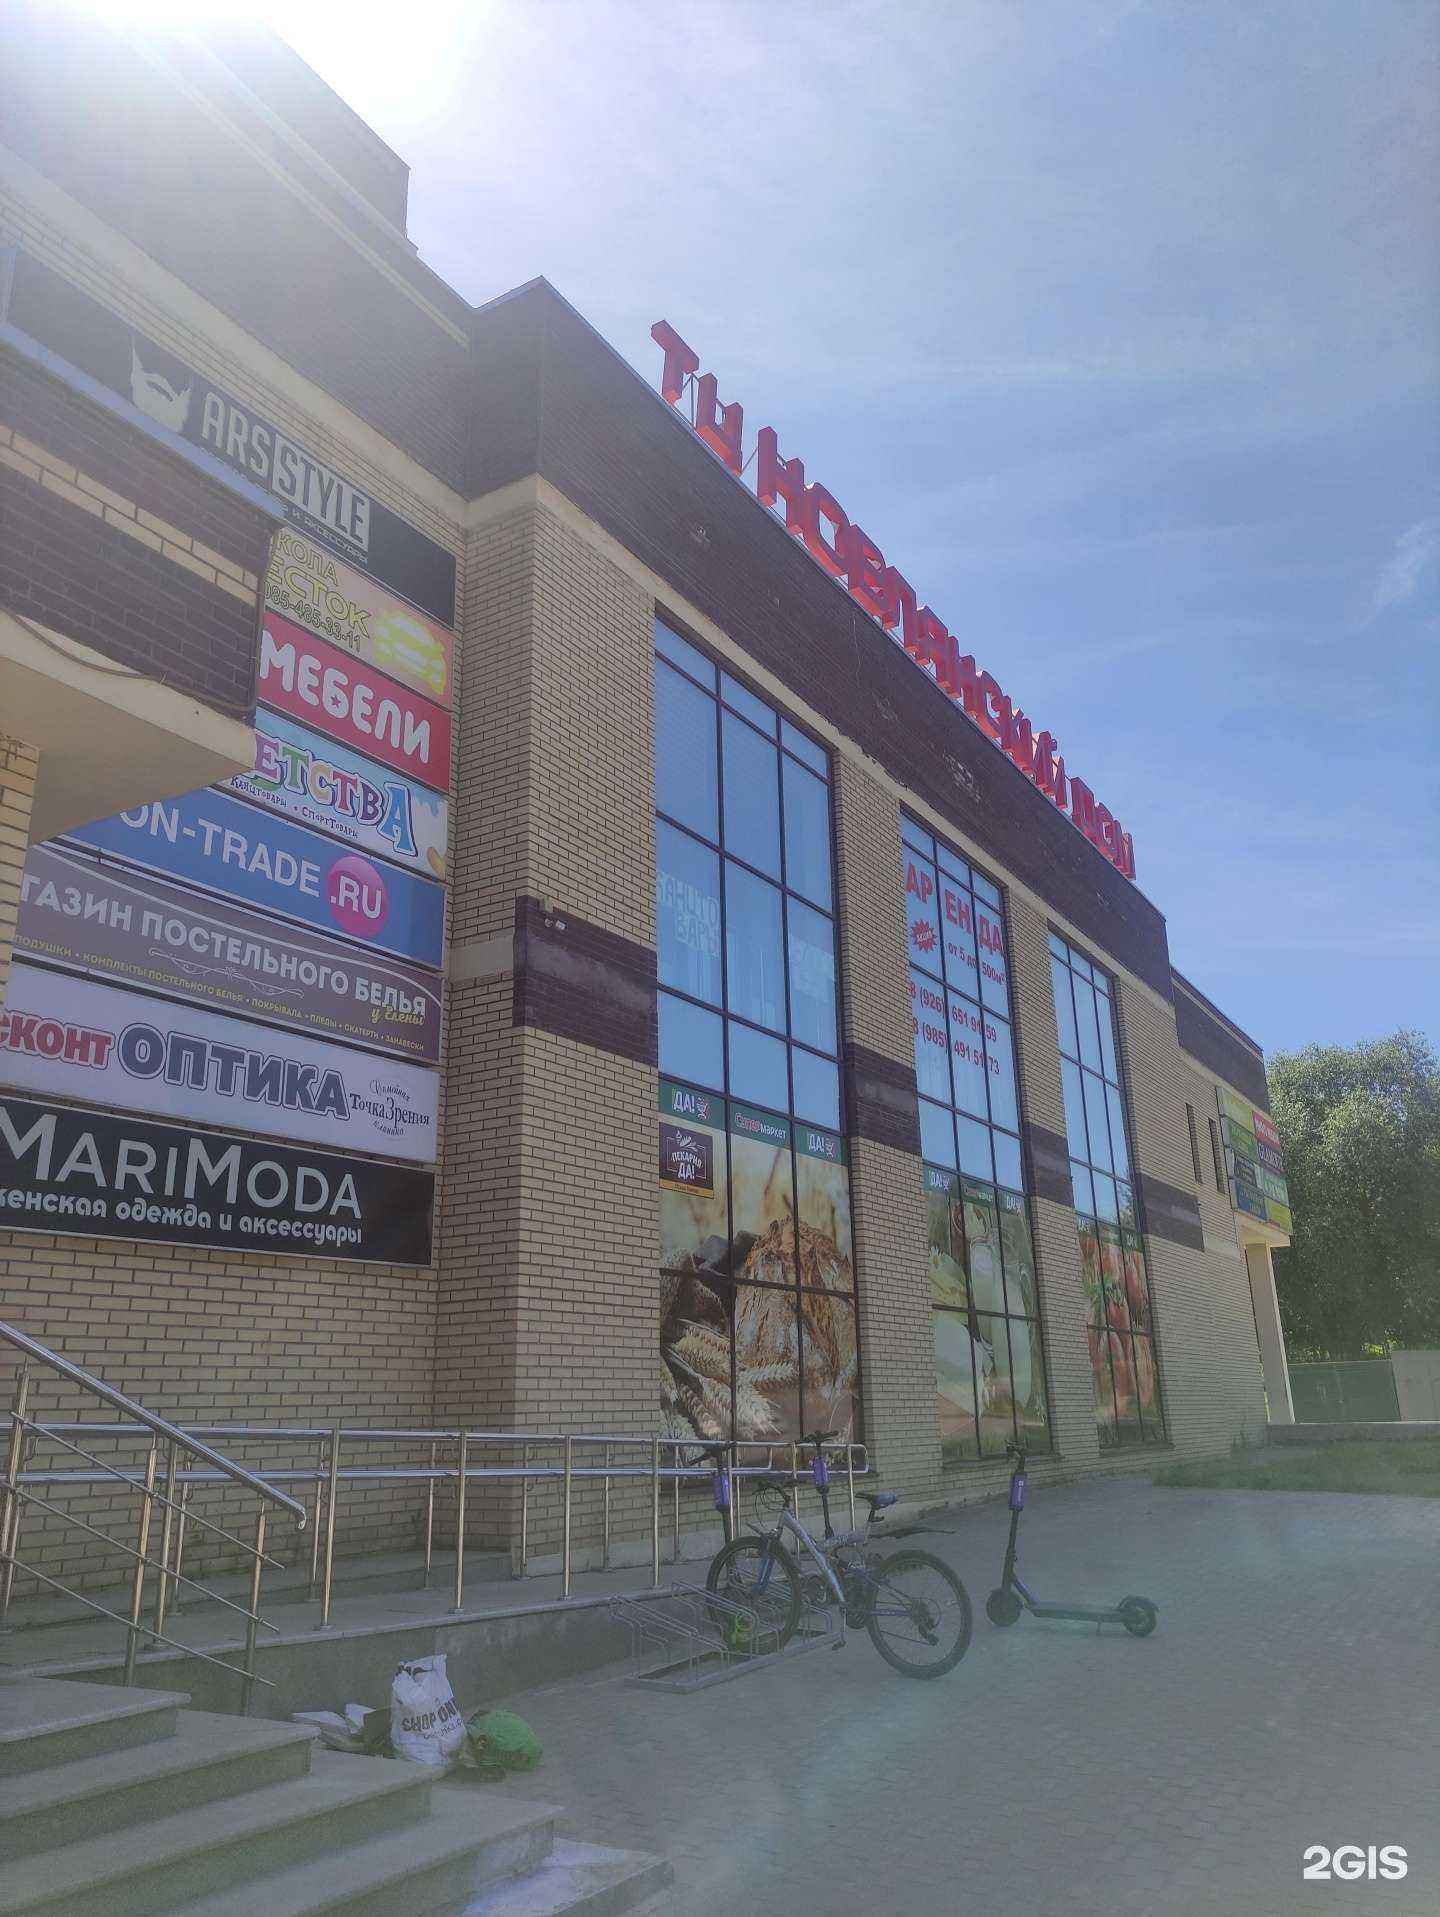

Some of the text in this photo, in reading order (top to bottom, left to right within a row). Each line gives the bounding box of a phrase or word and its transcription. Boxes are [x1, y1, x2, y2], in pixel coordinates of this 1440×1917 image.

[260, 630, 431, 764] МЕБЕЛИ
[20, 874, 426, 1017] ГАЗИН ПОСТЕЛЬНОГО БЕЛЬЯ
[149, 970, 215, 995] ПОСТЕЛЬНОГО
[118, 1022, 350, 1121] ОПТИКА
[115, 1199, 211, 1229] одежда
[219, 1214, 233, 1231] и
[239, 1216, 363, 1246] аксессуары
